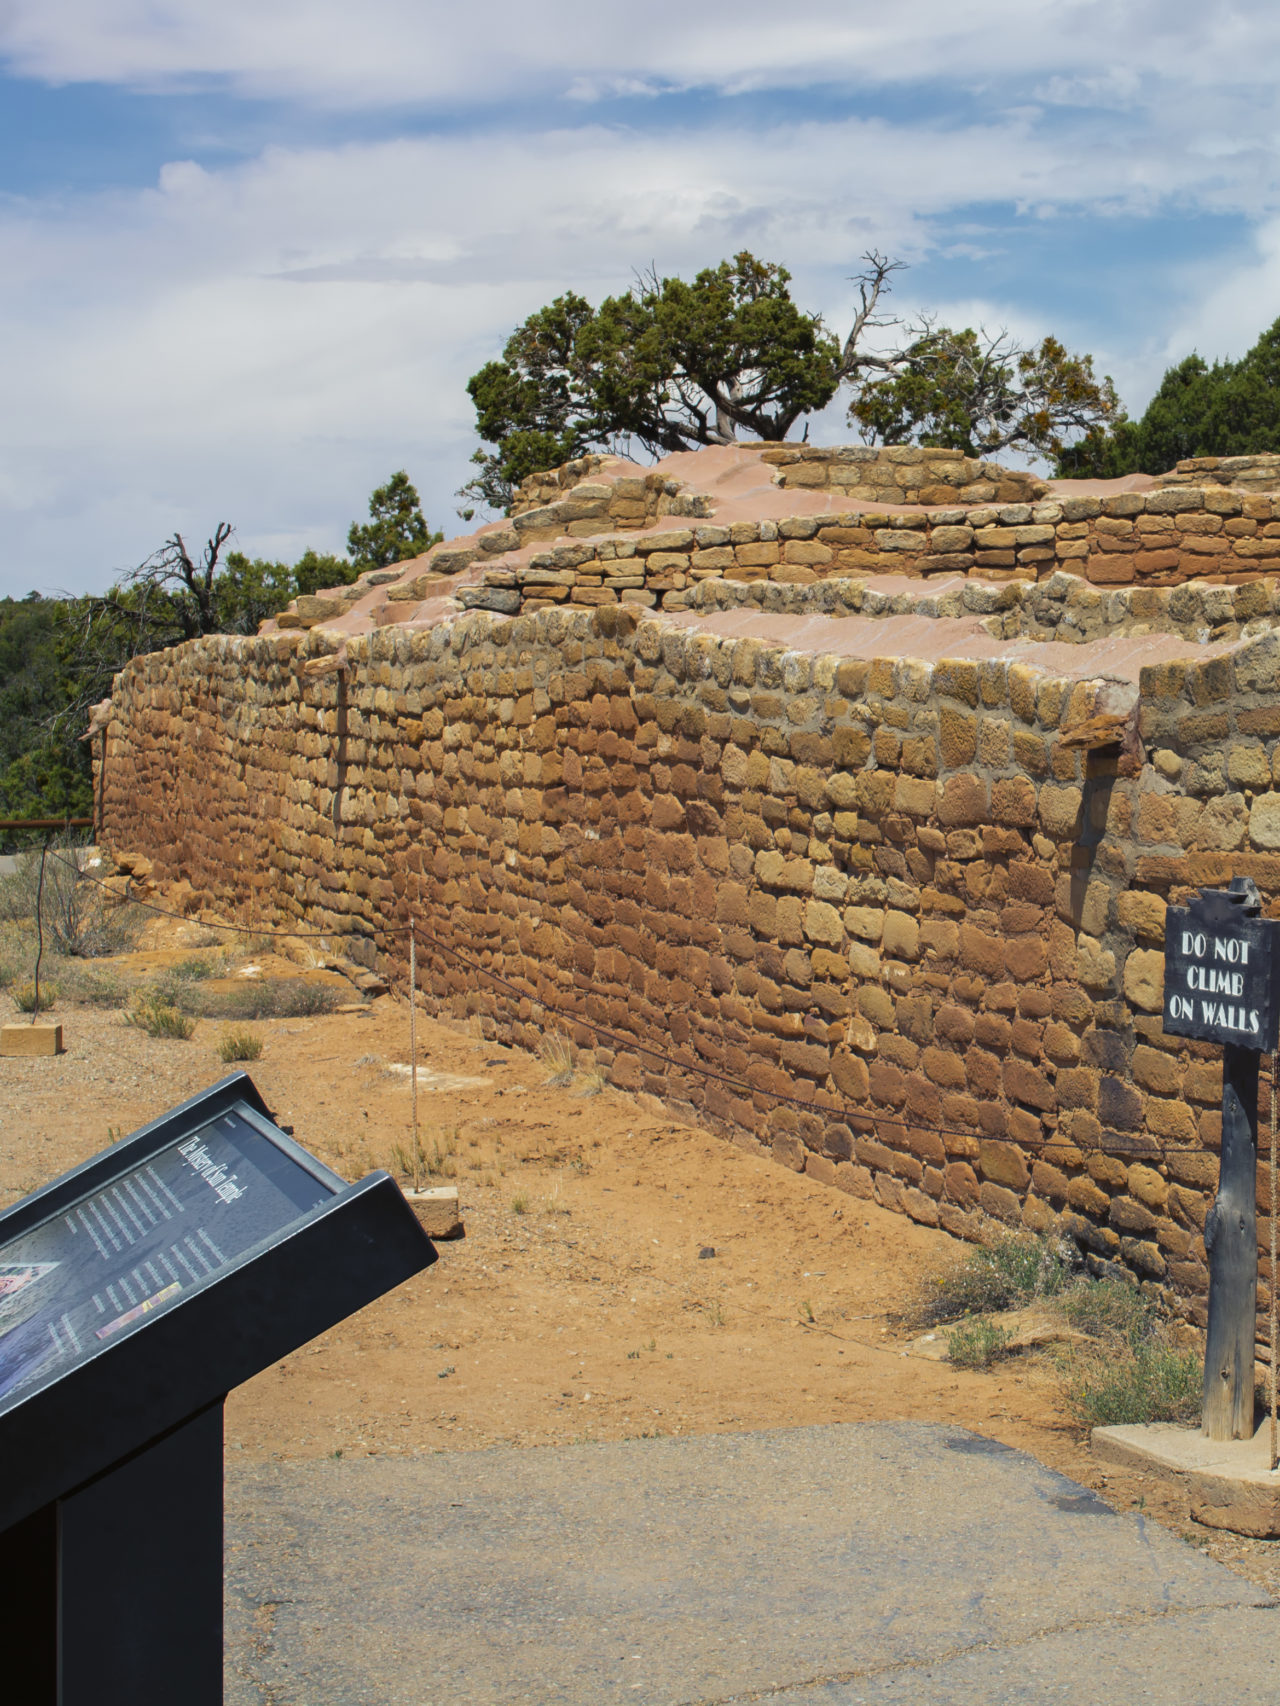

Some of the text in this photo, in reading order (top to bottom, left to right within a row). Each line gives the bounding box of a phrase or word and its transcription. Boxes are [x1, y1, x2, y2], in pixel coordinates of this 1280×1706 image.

[1182, 931, 1251, 964] DO NOT
[1187, 965, 1244, 996] CLIMB
[1169, 995, 1259, 1033] ON WALLS
[177, 1136, 200, 1155] The
[182, 1144, 214, 1176] Mystery
[215, 1174, 248, 1203] Temple
